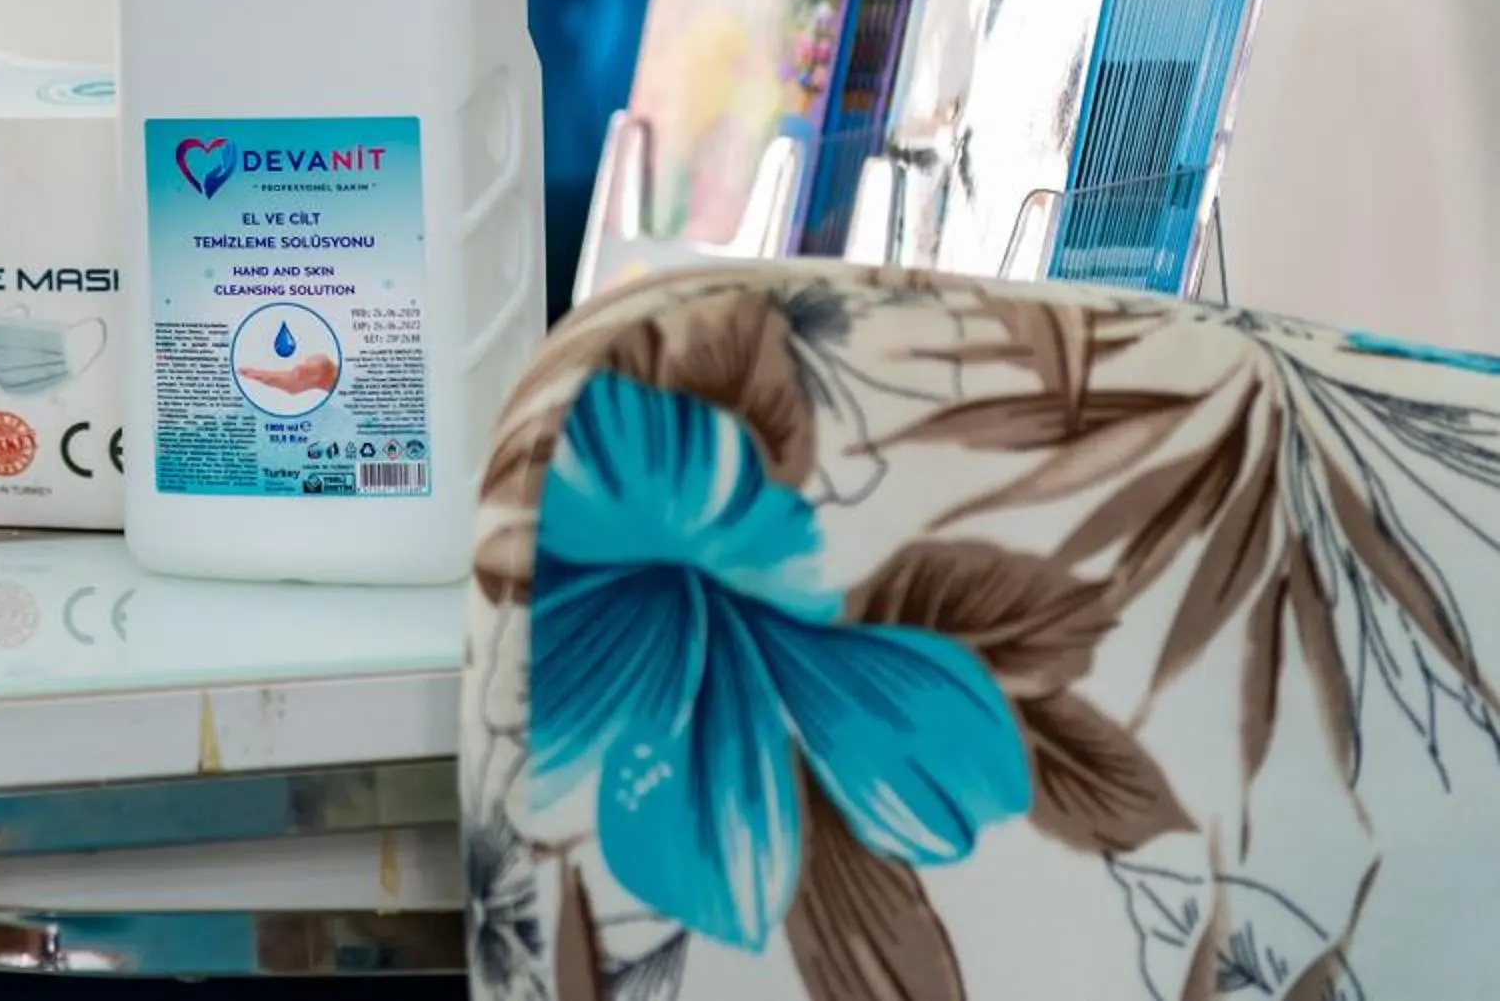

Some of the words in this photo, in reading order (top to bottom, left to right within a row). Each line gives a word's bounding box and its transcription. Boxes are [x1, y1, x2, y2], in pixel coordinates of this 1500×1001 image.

[242, 212, 261, 226] EL
[265, 212, 286, 226] VE
[193, 235, 276, 249] TEMİZLEME
[281, 235, 375, 249] SOLÜSYONU
[233, 266, 269, 277] HAND
[273, 266, 301, 277] AND
[304, 266, 335, 277] SKIN
[213, 284, 285, 296] CLEANSING
[289, 284, 356, 296] SOLUTION
[263, 466, 300, 480] Turkey
